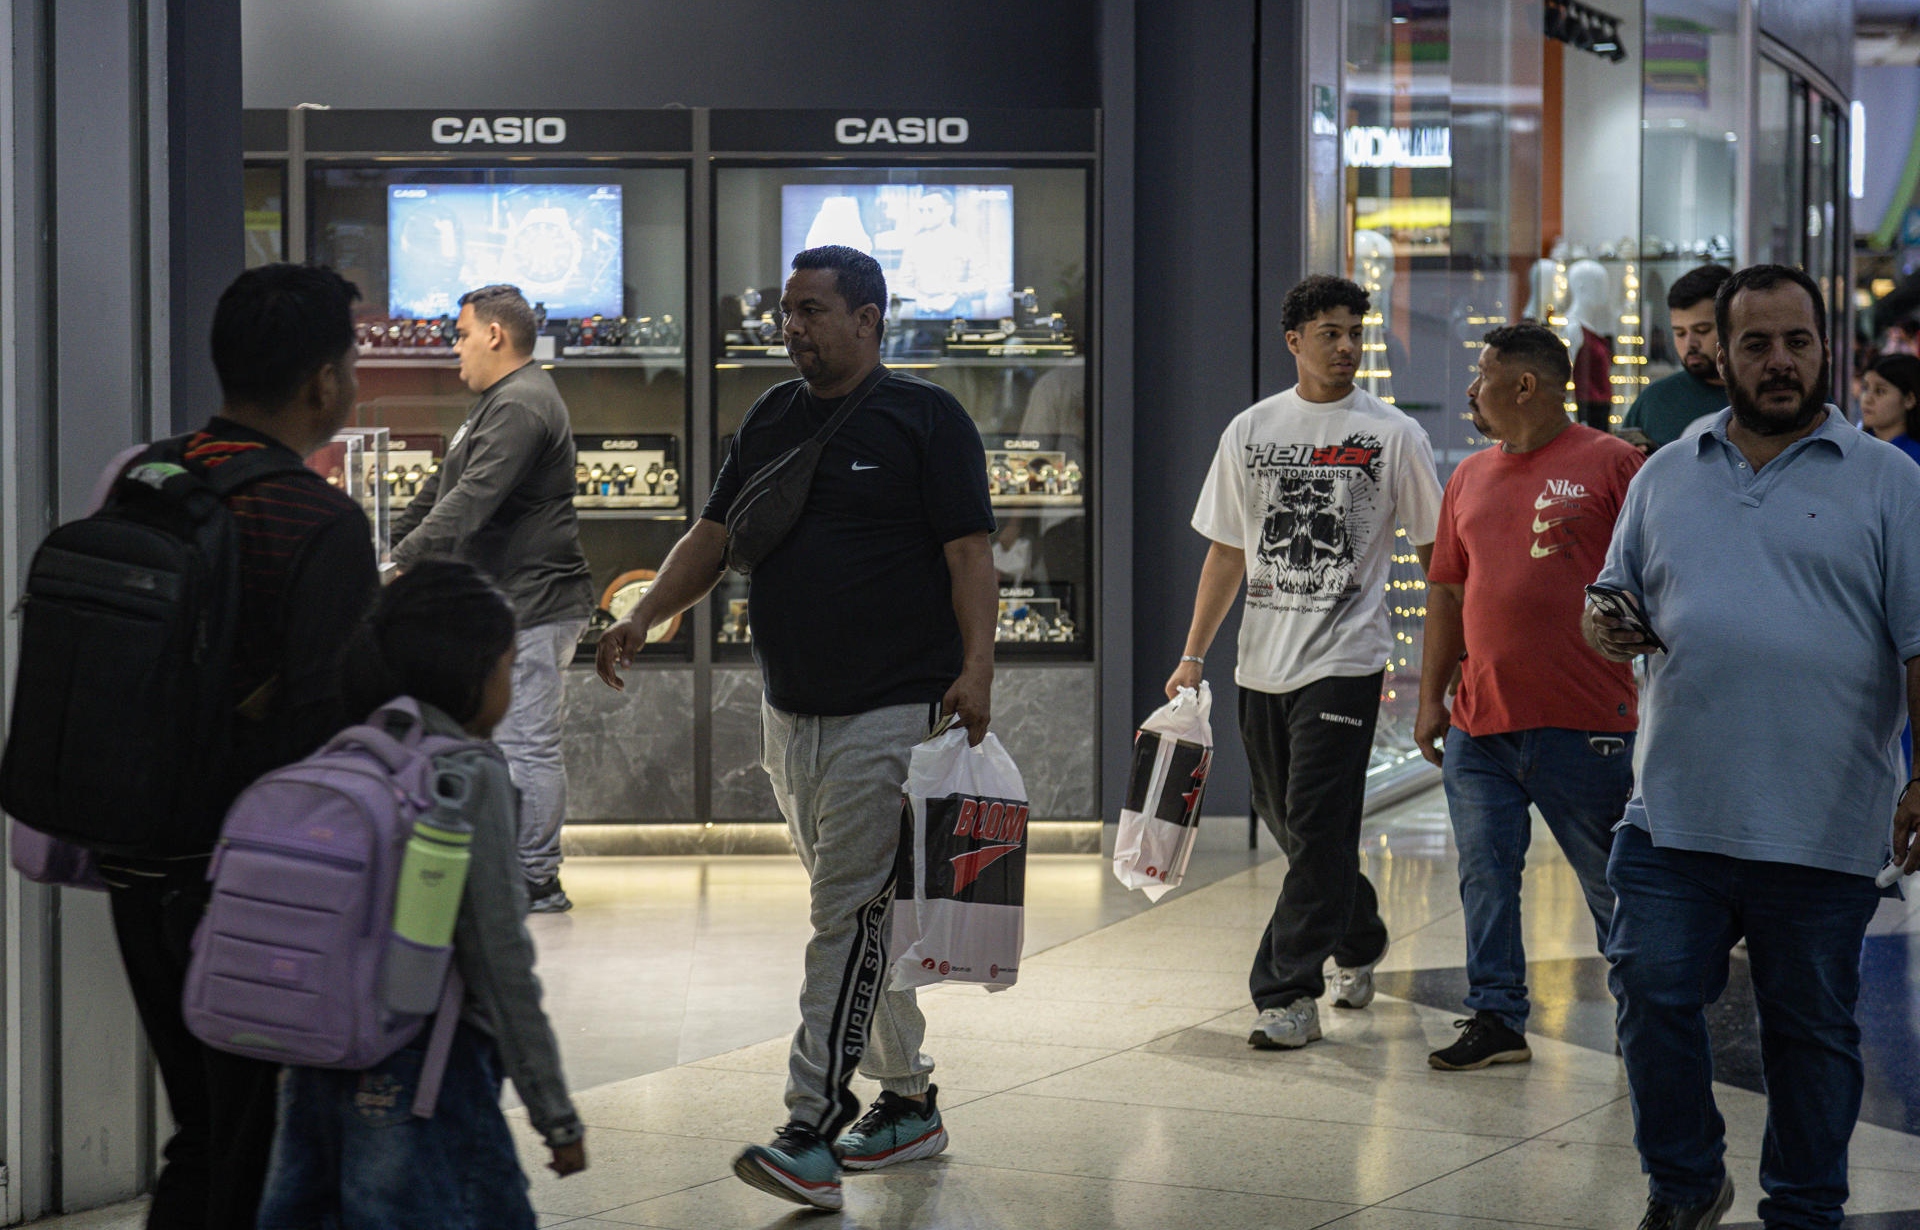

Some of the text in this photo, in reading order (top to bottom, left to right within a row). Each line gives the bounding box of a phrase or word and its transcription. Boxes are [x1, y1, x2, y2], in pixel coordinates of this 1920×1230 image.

[431, 117, 567, 144] CASIO
[835, 117, 969, 144] CASIO
[602, 440, 638, 450] CASIO
[1004, 440, 1040, 450] CASIO
[1257, 469, 1281, 479] PATH
[1284, 469, 1299, 479] TO
[1544, 479, 1591, 498] Nike
[1000, 588, 1035, 597] CASIO
[1320, 712, 1363, 727] ESSENTIALS
[952, 798, 1029, 843] BOOM
[844, 980, 874, 1058] SUPER
